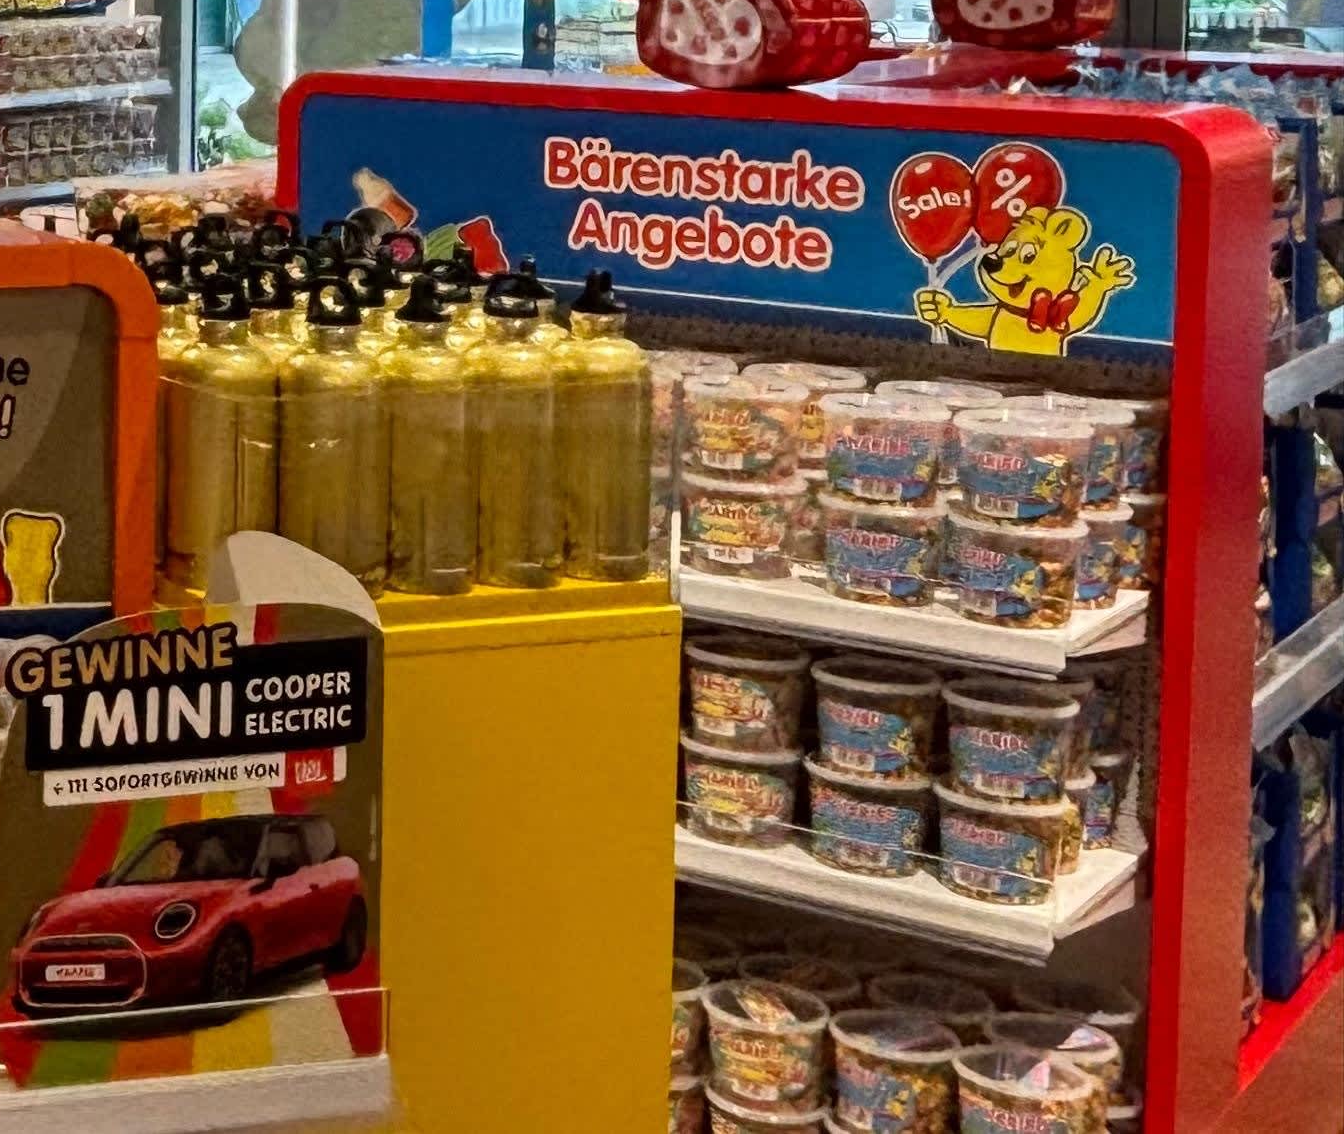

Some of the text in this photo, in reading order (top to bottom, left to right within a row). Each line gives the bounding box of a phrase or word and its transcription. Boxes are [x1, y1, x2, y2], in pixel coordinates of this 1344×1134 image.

[546, 137, 862, 209] Bärenstarke
[898, 186, 972, 220] Sale!
[570, 200, 830, 268] Angebote
[11, 627, 234, 693] GEWINNE
[245, 671, 351, 703] COOPER
[41, 680, 234, 751] 1 MINI
[244, 704, 352, 736] ELECTRIC
[92, 765, 238, 793] SOFORTGEWINNE
[244, 763, 280, 779] VON
